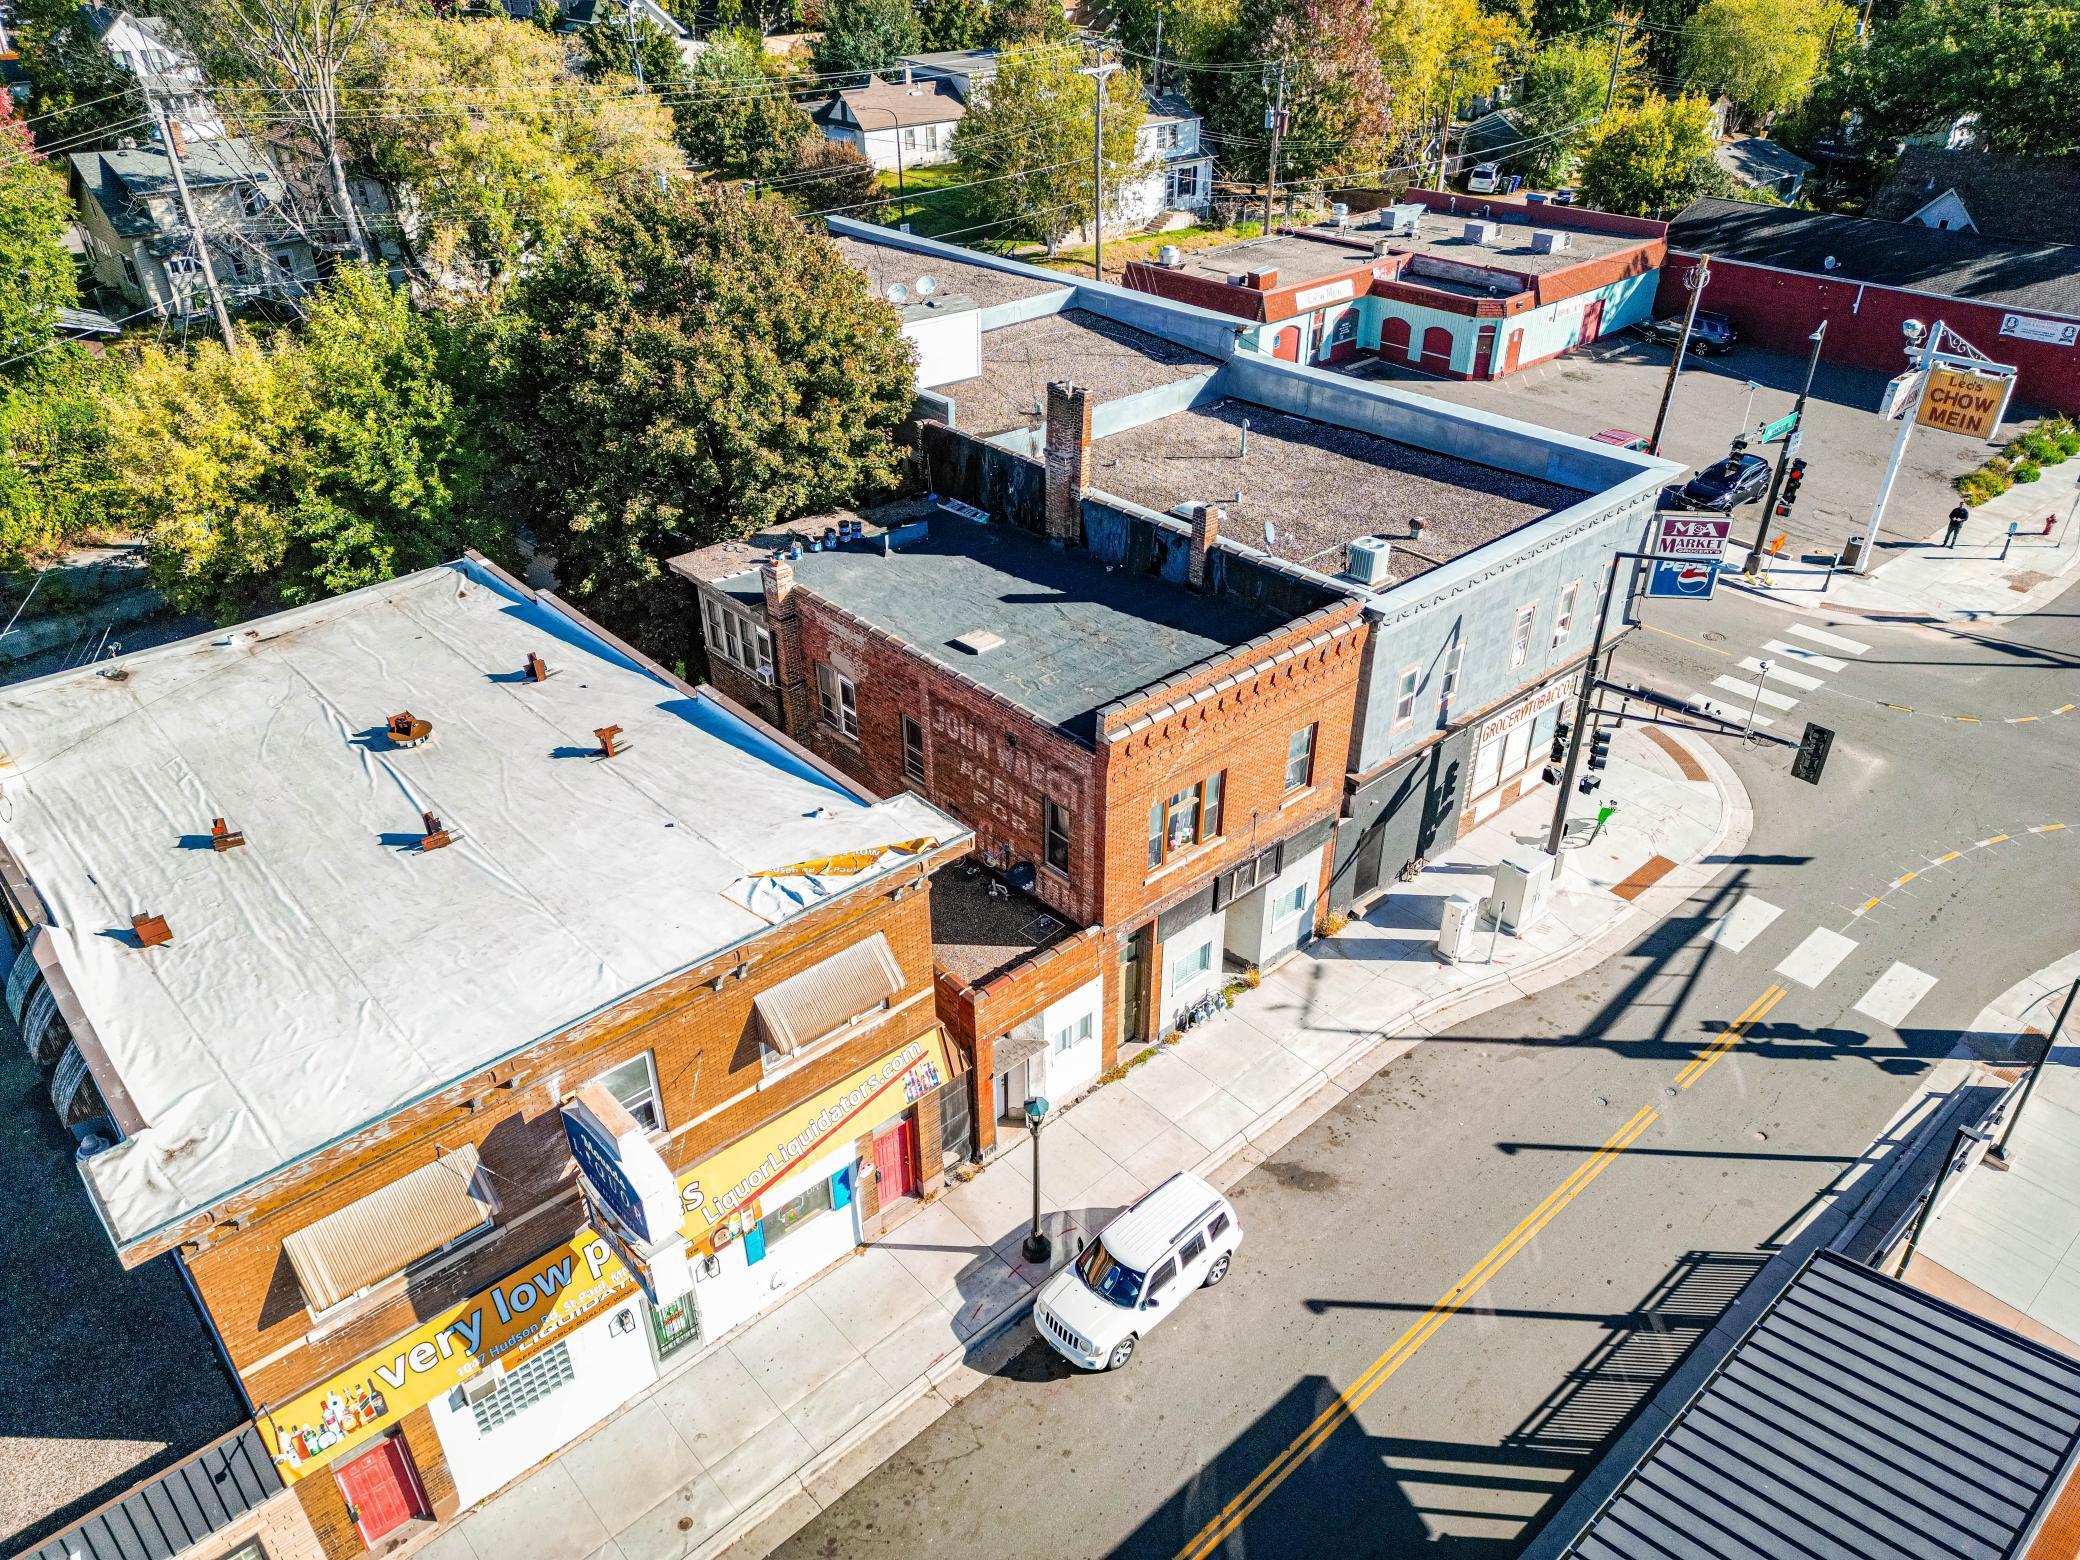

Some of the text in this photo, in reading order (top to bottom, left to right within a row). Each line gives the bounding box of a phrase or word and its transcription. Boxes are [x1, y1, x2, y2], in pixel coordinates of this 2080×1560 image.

[1948, 375, 1984, 392] Leo's
[1930, 387, 1995, 413] CHOW
[1928, 407, 1982, 432] MEIN
[1672, 522, 1719, 536] M&A
[1659, 538, 1725, 553] MARKET
[1660, 560, 1712, 573] PEPSI
[973, 789, 1027, 832] FOR
[701, 1041, 922, 1226] LiquorLiquidators.com
[374, 1308, 482, 1390] very
[491, 1255, 573, 1325] low
[517, 1325, 574, 1363] AFFORDABLE
[576, 1301, 611, 1326] QUALITY
[489, 1324, 539, 1358] Hudson
